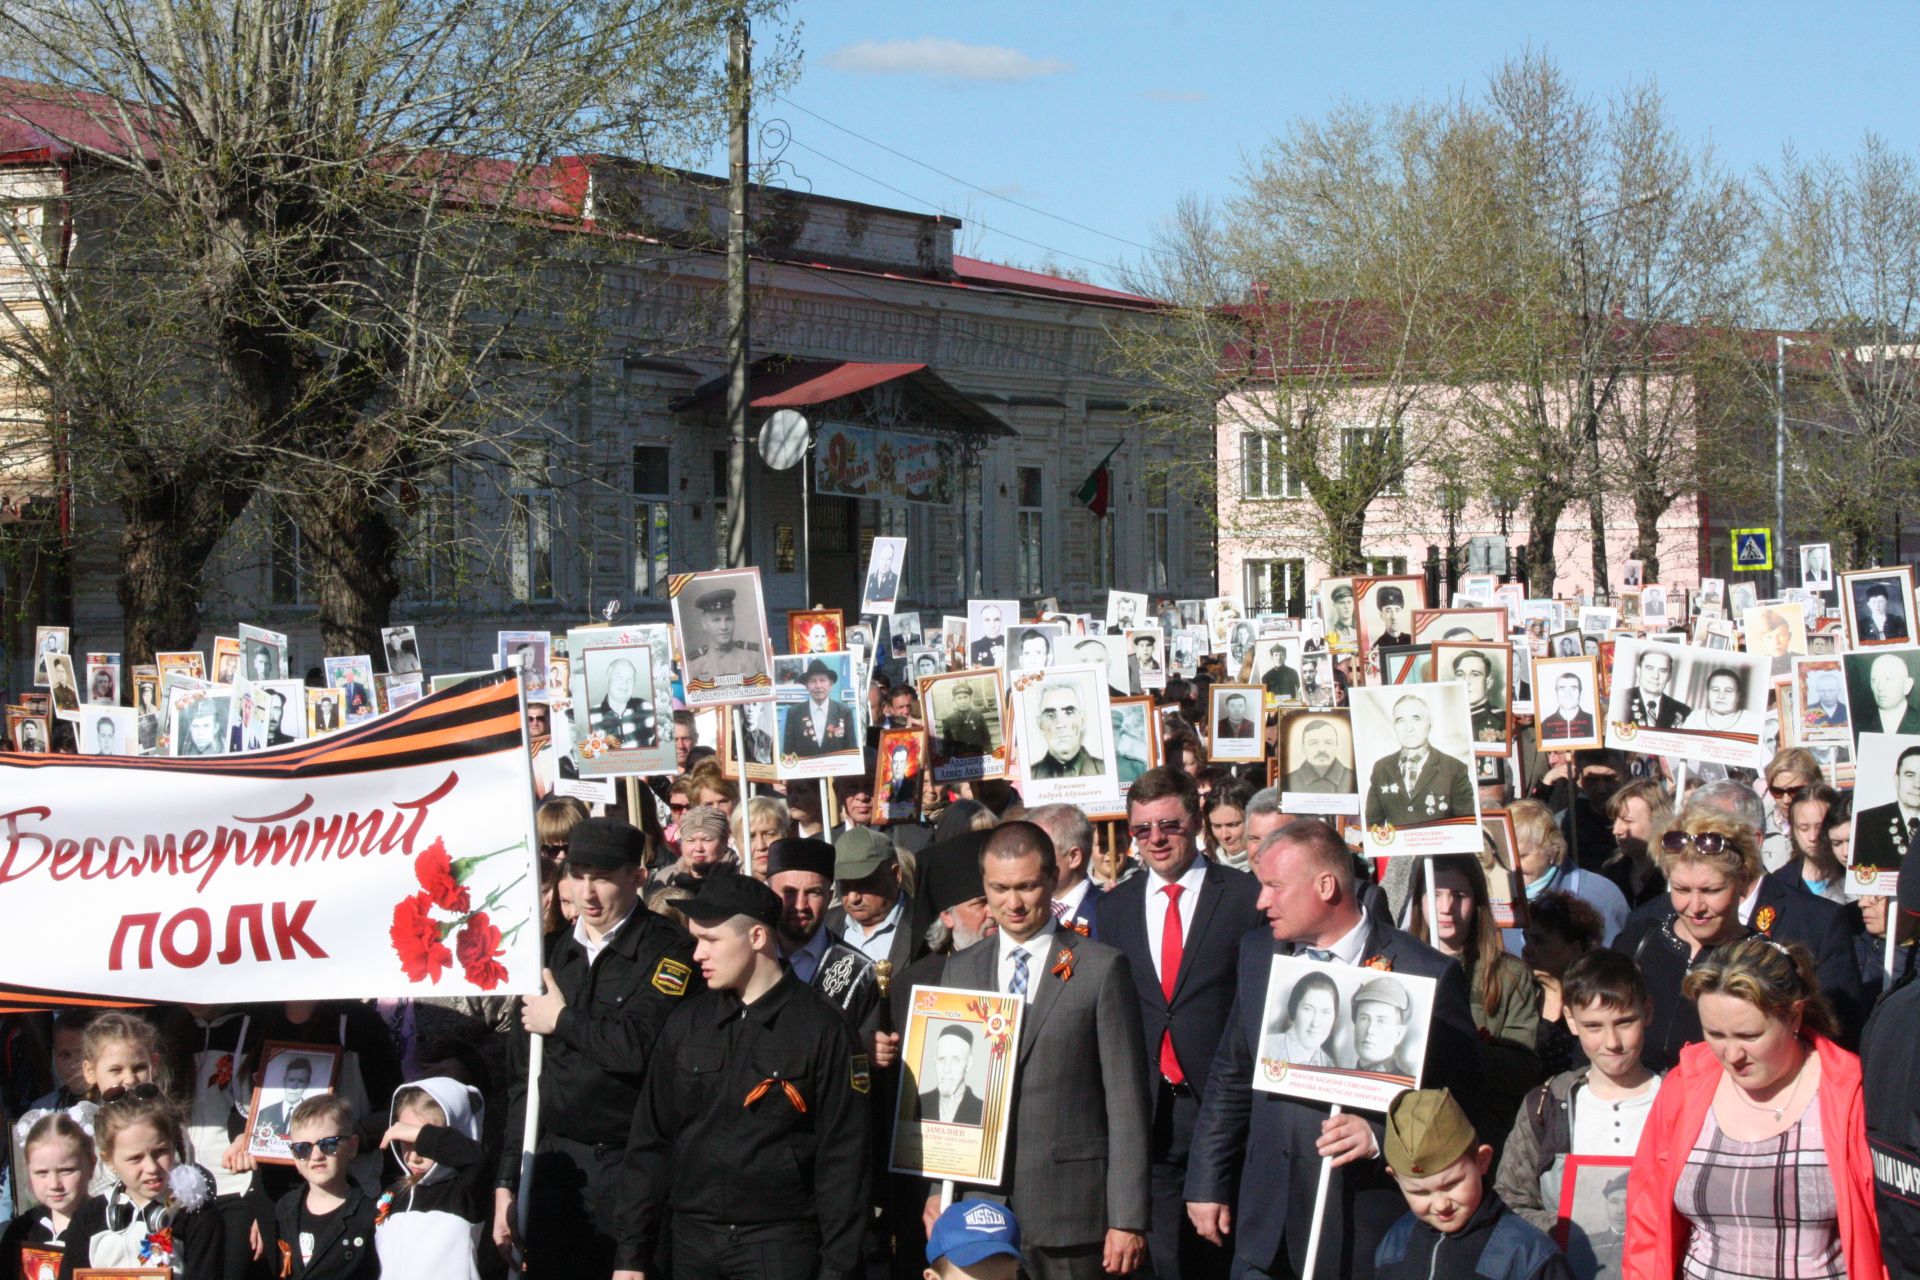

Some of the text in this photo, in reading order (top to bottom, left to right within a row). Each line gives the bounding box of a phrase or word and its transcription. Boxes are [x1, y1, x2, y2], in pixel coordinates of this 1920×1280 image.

[0, 770, 460, 894] Бессмертный
[108, 900, 330, 971] ПОЛК
[1870, 1147, 1920, 1196] ОЛИЦИЯ
[965, 1208, 1005, 1225] RUSSIA
